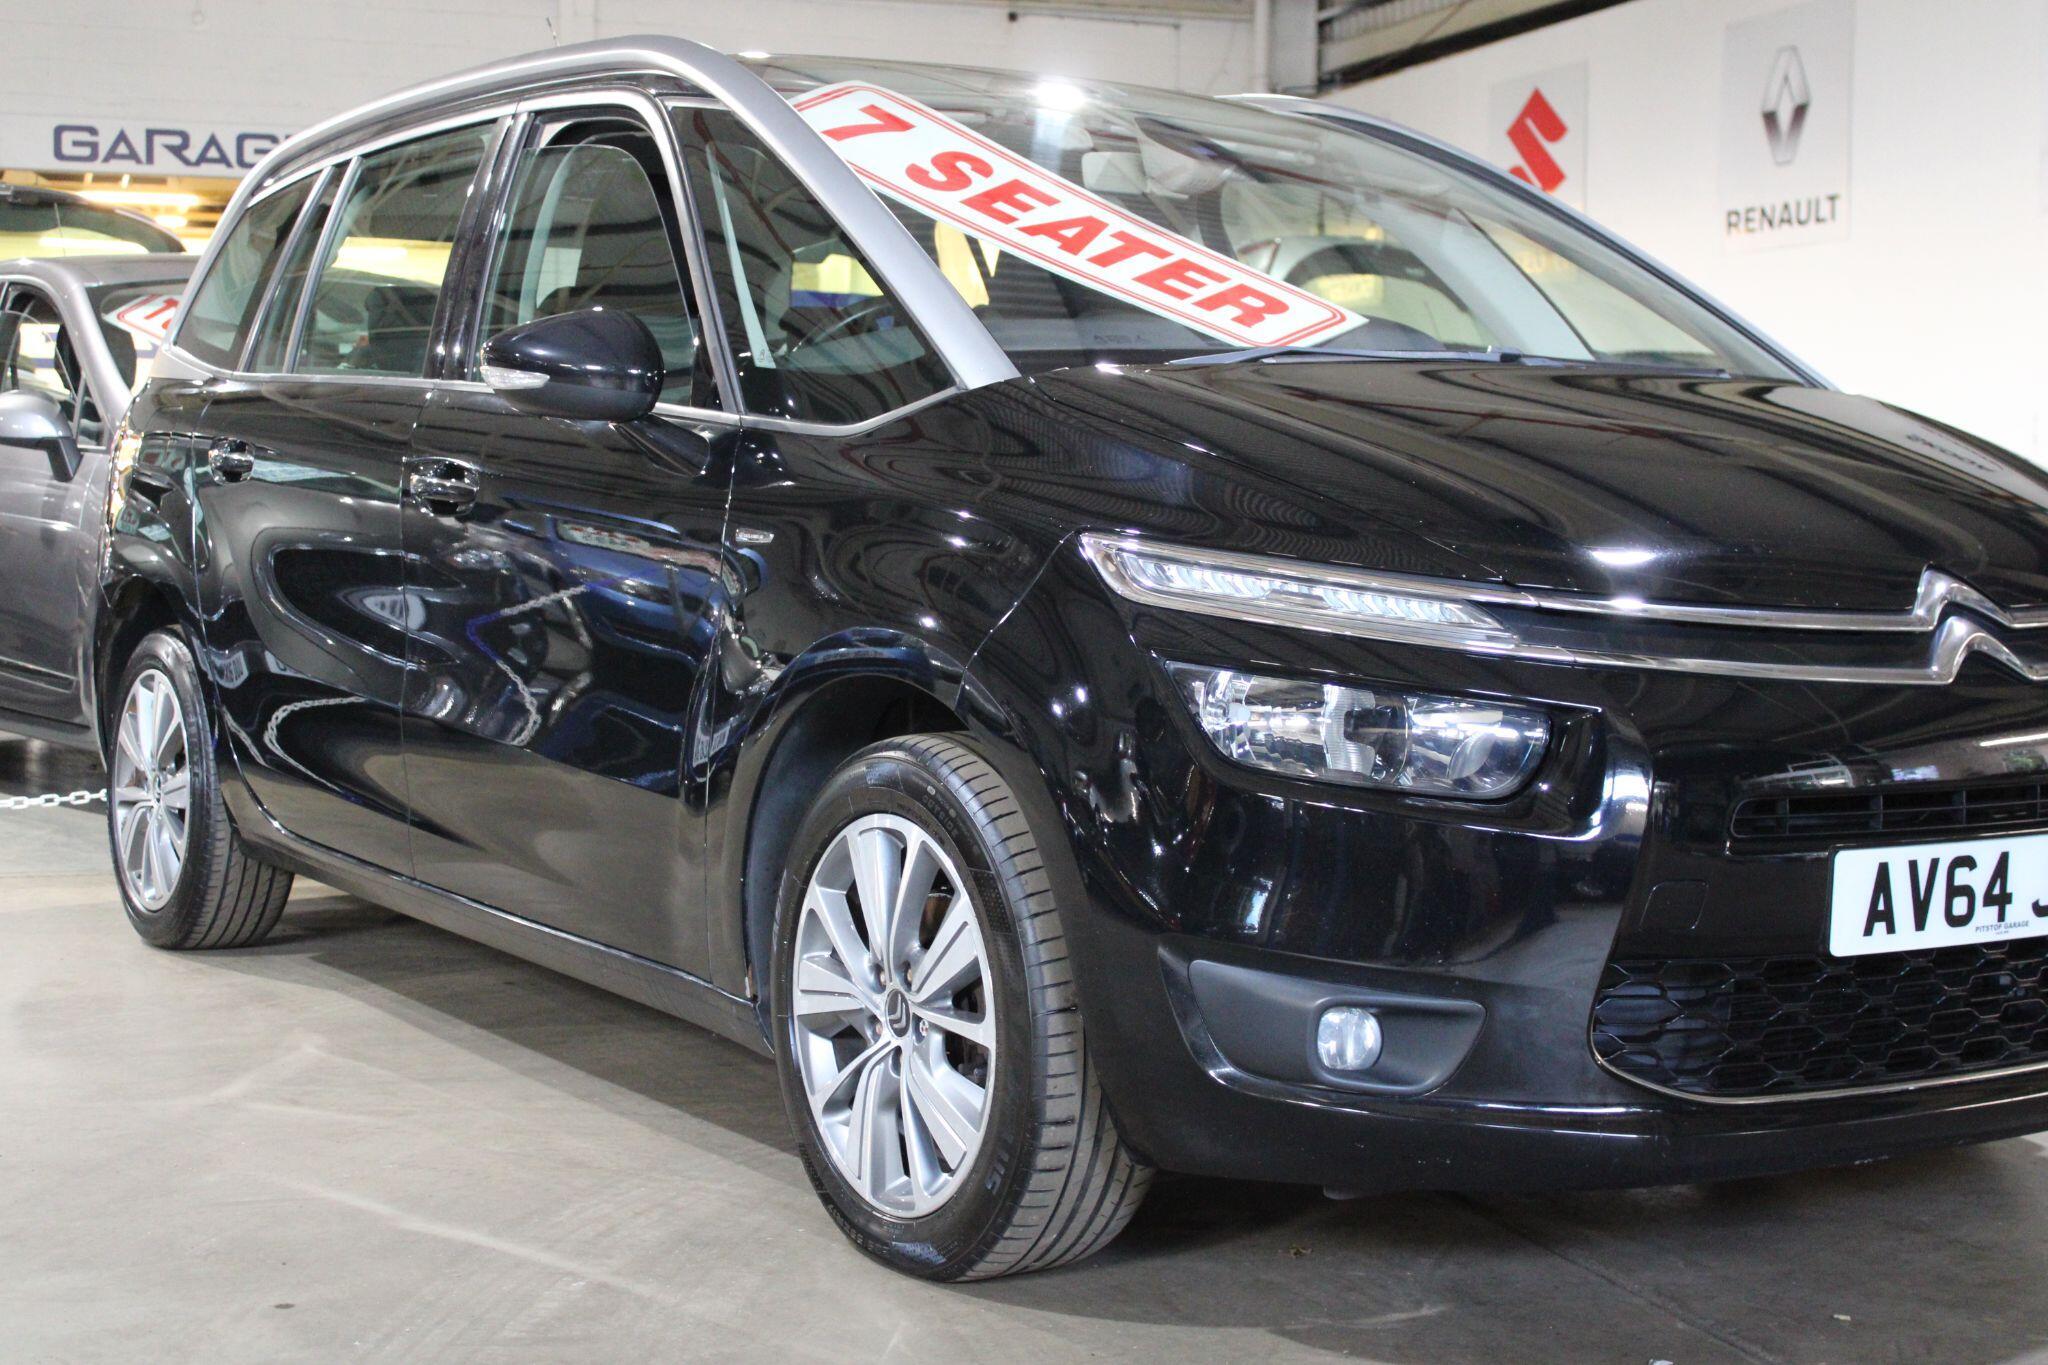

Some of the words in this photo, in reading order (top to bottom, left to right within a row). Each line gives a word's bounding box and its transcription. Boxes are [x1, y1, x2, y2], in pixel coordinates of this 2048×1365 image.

[53, 124, 292, 169] GARAG
[820, 103, 916, 142] 7
[904, 150, 1291, 329] SEATER
[1726, 192, 1841, 235] RENAULT
[1862, 850, 2014, 937] AV64
[2003, 920, 2030, 930] GARAGE
